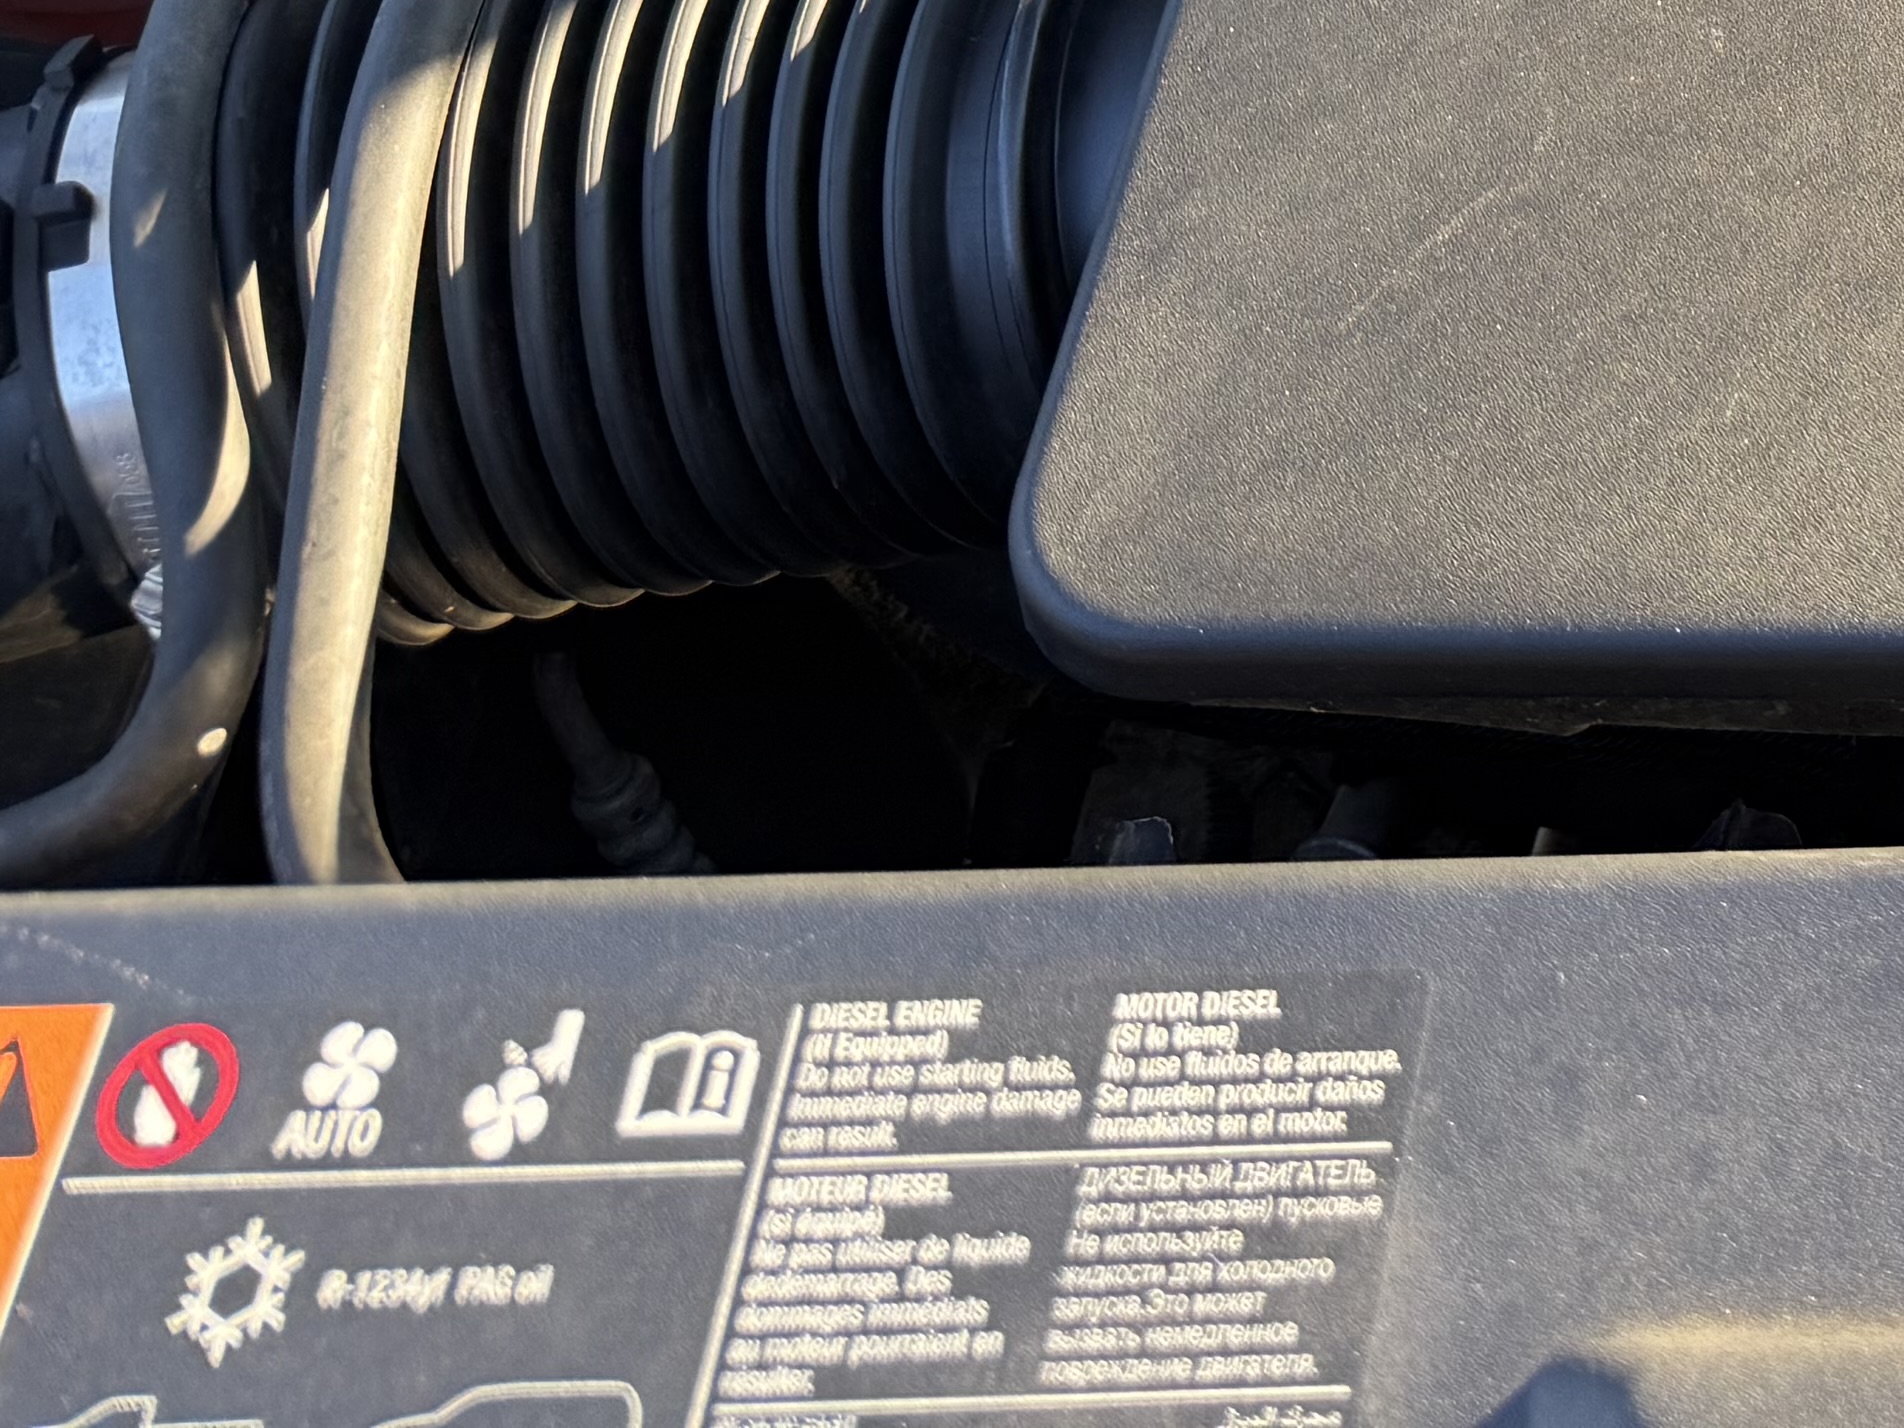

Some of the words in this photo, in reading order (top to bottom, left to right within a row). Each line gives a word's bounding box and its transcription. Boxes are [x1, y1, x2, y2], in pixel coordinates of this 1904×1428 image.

[808, 1001, 890, 1030] DIESEL
[893, 998, 983, 1030] ENGINE
[1112, 991, 1199, 1020] MOTOR
[1201, 989, 1282, 1019] DIESEL
[834, 1029, 949, 1061] Equipped)
[1107, 1022, 1143, 1052] (Si
[1144, 1022, 1169, 1052] lo
[1172, 1020, 1239, 1052] tiene)
[795, 1063, 829, 1092] Do
[830, 1063, 871, 1091] not
[871, 1064, 915, 1091] use
[917, 1059, 1005, 1091] starting
[1006, 1055, 1076, 1086] fluids.
[1101, 1052, 1135, 1082] No
[1137, 1055, 1181, 1081] use
[1184, 1050, 1260, 1080] fluidos
[1262, 1048, 1293, 1077] de
[1295, 1049, 1402, 1078] arranque.
[786, 1092, 908, 1122] Immediate
[909, 1089, 987, 1124] engine
[989, 1088, 1083, 1120] damage
[1094, 1081, 1129, 1113] Se
[1130, 1081, 1216, 1113] pueden
[1217, 1078, 1313, 1110] producir
[1314, 1074, 1387, 1105] daños
[270, 1106, 383, 1160] AUTO
[778, 1126, 825, 1154] can
[825, 1120, 899, 1152] result.
[1088, 1112, 1215, 1143] inmediatos
[1216, 1113, 1248, 1141] en
[1249, 1108, 1275, 1139] el
[1276, 1109, 1348, 1138] motor.
[766, 1174, 868, 1208] MOTEUR
[869, 1172, 953, 1207] DIESEL
[1076, 1159, 1233, 1200] ДИЗЕЛЬНЫЙ
[1233, 1158, 1377, 1195] ДВИГАТЕЛЬ
[1074, 1199, 1136, 1229] (если
[1138, 1194, 1275, 1230] установлен)
[1277, 1194, 1384, 1229] пусковые
[916, 1232, 950, 1266] de
[1064, 1229, 1101, 1262] Не
[1102, 1225, 1245, 1261] используйте
[902, 1264, 953, 1298] Des
[1055, 1263, 1167, 1293] жидкости
[1167, 1261, 1214, 1290] для
[1215, 1256, 1337, 1289] холодного
[1191, 1290, 1268, 1322] может
[1143, 1320, 1299, 1353] немедленное
[1194, 1352, 1320, 1385] двигателя.
